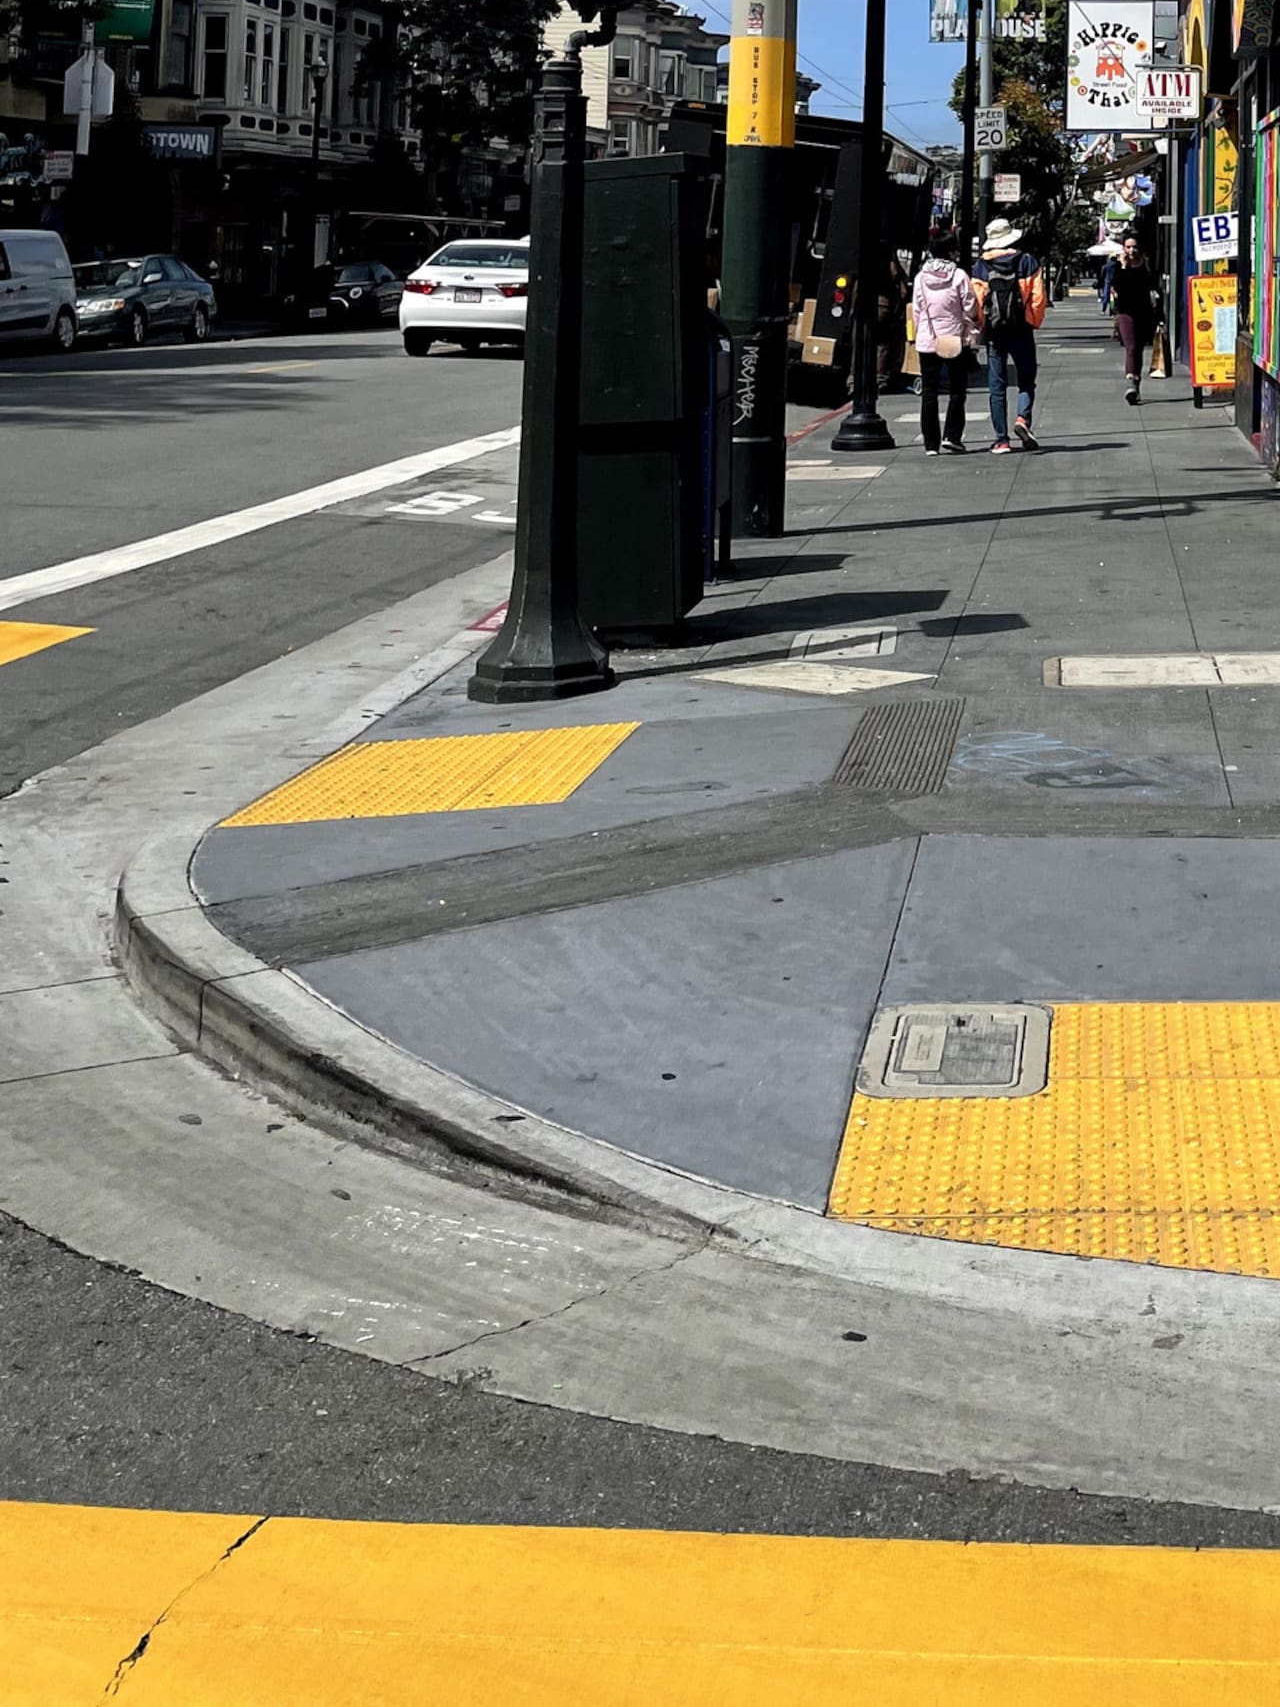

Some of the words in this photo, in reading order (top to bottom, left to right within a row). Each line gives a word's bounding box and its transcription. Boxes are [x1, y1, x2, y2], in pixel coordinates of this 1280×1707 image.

[1142, 73, 1191, 97] ATM
[1141, 100, 1192, 108] AVAILABLE
[975, 109, 1004, 120] SPEED
[1151, 107, 1182, 115] INSIDE
[978, 120, 1000, 128] LIMIT
[977, 129, 1003, 146] 20
[1197, 214, 1239, 243] EB
